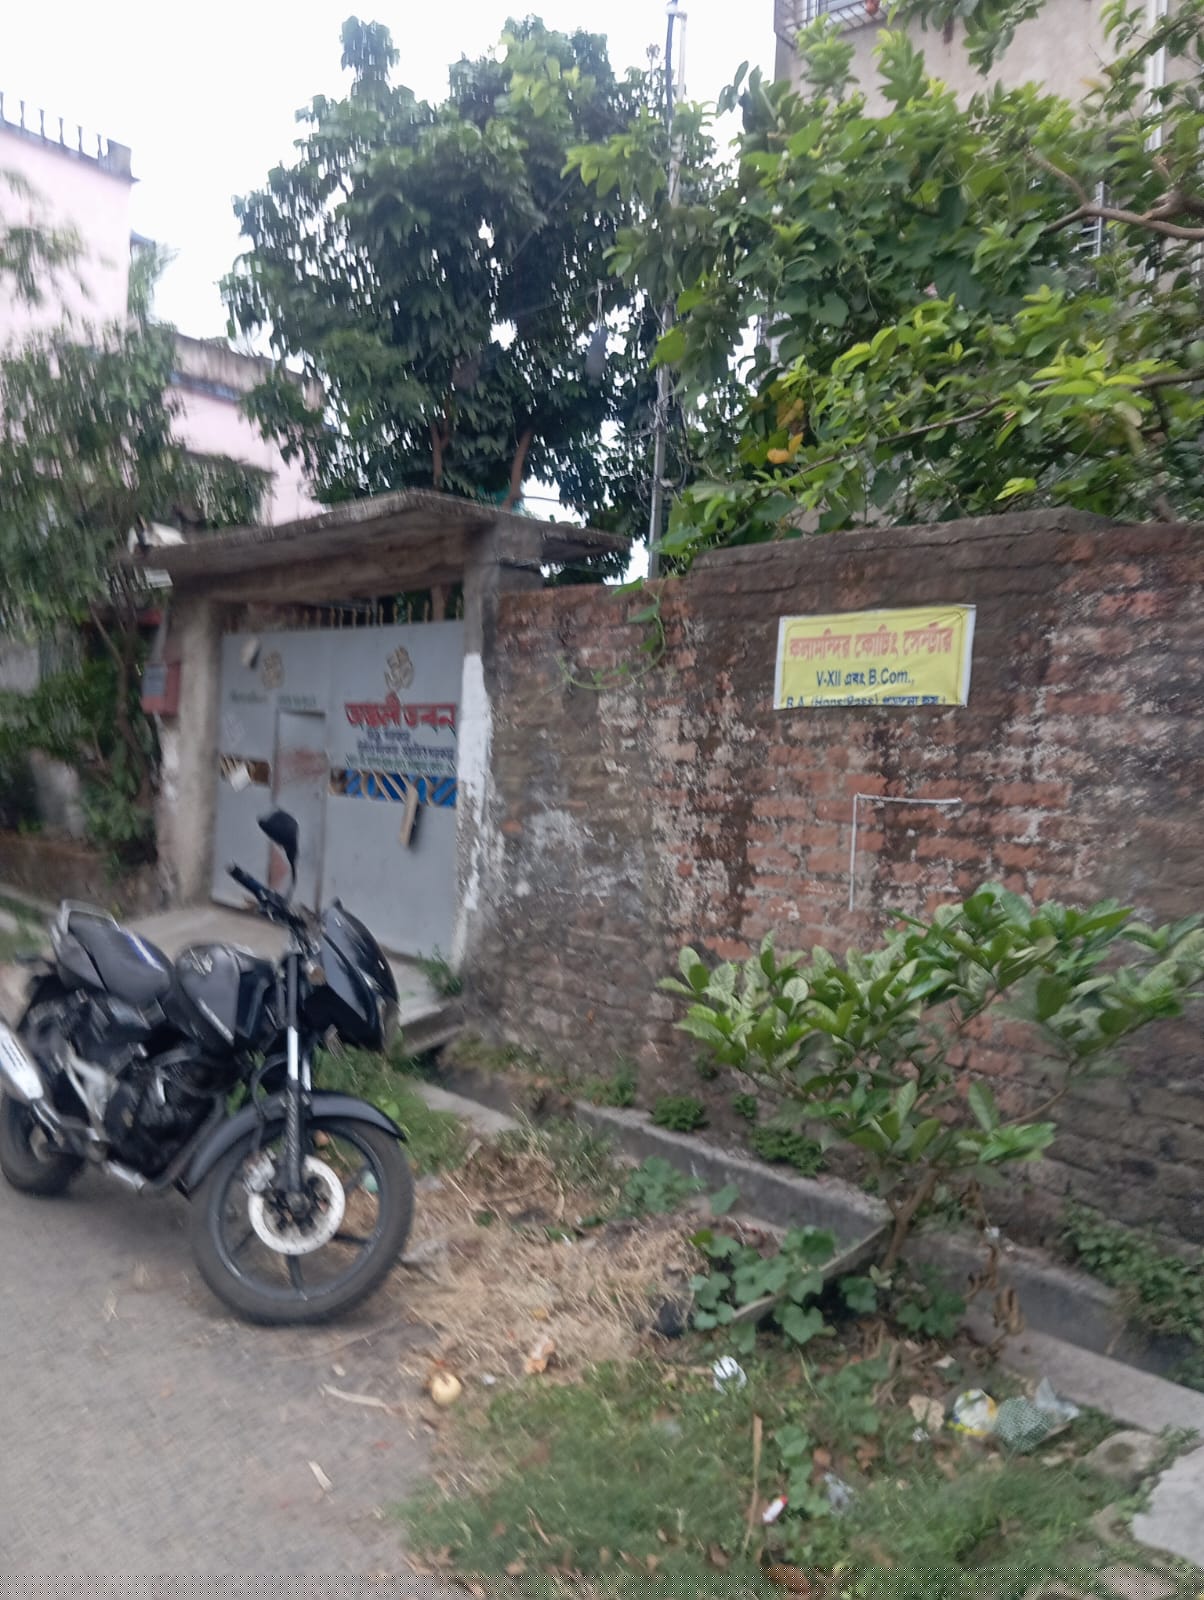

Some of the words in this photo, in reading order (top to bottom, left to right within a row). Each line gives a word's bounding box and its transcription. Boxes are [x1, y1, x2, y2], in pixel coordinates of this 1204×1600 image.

[855, 624, 898, 656] কোচিং
[904, 621, 953, 656] সেন্টার
[816, 669, 841, 687] V-XII
[844, 671, 865, 686] এবং
